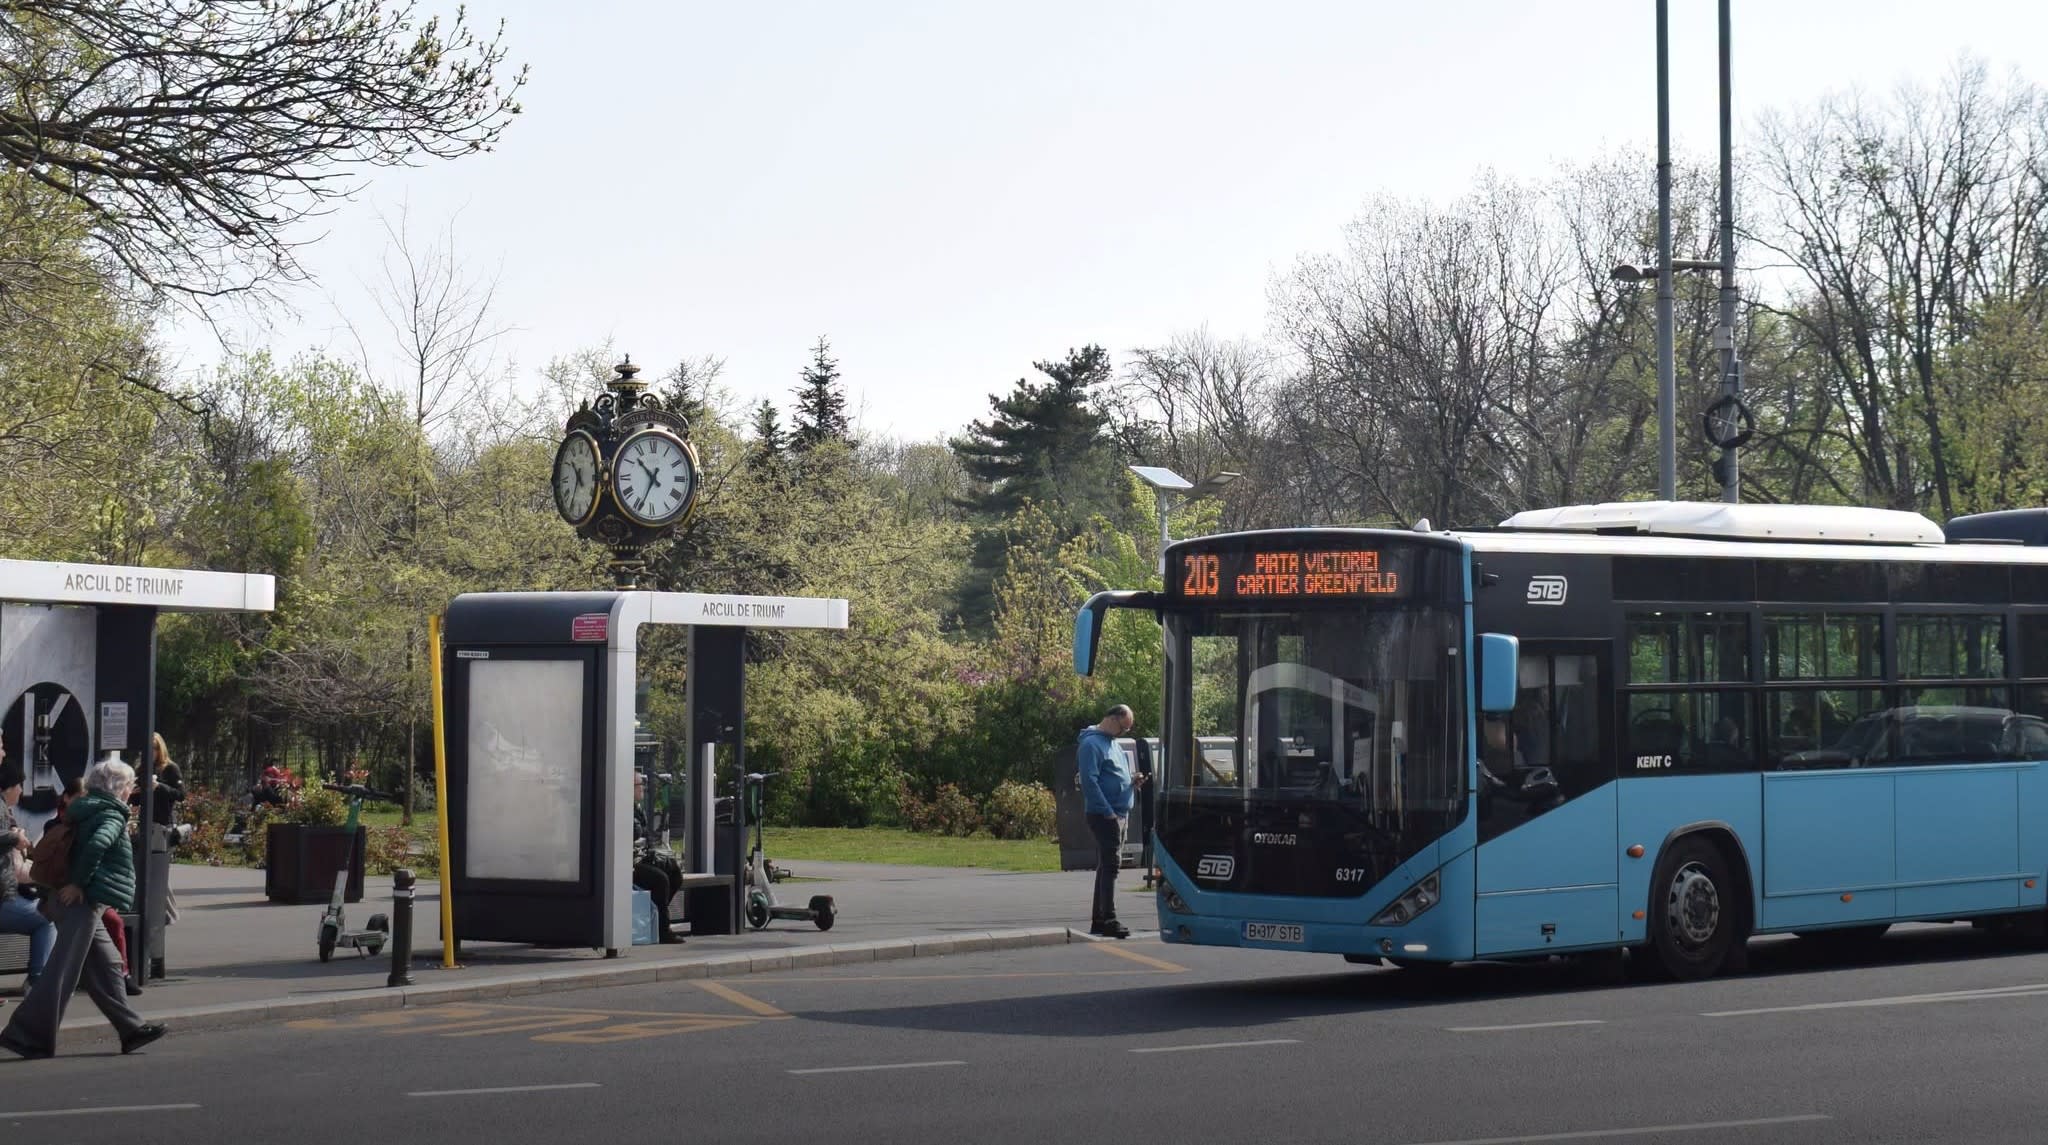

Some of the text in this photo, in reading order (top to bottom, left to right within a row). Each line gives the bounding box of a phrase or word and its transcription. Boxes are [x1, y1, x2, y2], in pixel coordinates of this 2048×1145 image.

[1255, 552, 1378, 573] PIATA VICTORIEI
[1184, 555, 1219, 596] 203
[1236, 572, 1397, 595] CARTIER GREENFIELD
[65, 574, 184, 596] ARCUL DE TRIUMF
[1527, 580, 1564, 599] STB
[702, 602, 785, 619] ARCUL DE TRIUMF
[1636, 755, 1672, 769] KENT C
[1254, 833, 1297, 846] OTOKAR
[1198, 859, 1232, 876] STB
[1336, 868, 1365, 882] 6317
[1279, 926, 1302, 941] STB
